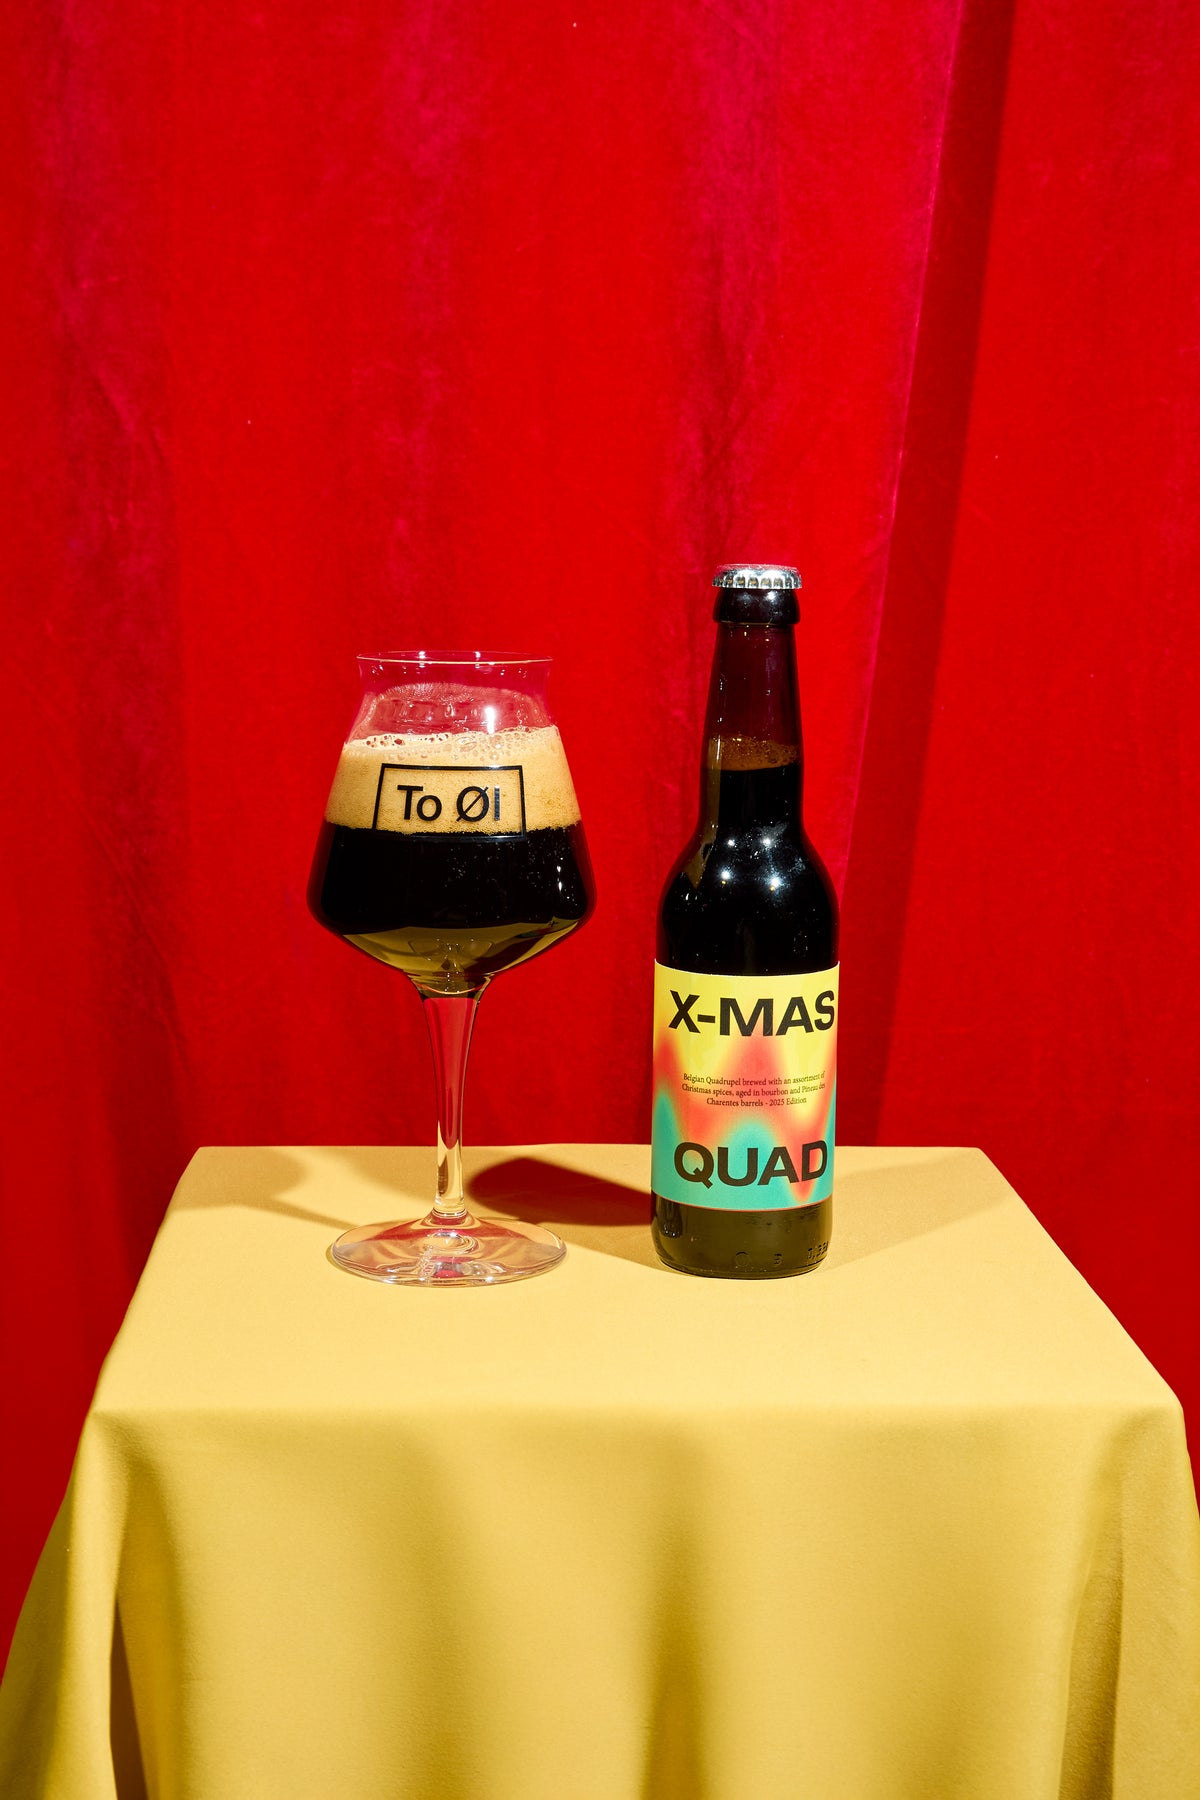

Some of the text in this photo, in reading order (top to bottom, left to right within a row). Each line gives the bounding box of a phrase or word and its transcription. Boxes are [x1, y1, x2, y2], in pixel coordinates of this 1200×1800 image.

[397, 785, 501, 822] To Øl
[668, 989, 835, 1037] X-MAS
[681, 1083, 712, 1094] Christmas
[712, 1087, 734, 1097] spices,
[735, 1088, 752, 1098] aged
[761, 1088, 789, 1097] bourbon
[790, 1086, 801, 1095] and
[802, 1085, 818, 1093] Pineau
[683, 1072, 705, 1084] Belgian
[706, 1076, 741, 1087] Quadrupel
[742, 1077, 767, 1086] brewed
[768, 1076, 783, 1086] with
[793, 1073, 820, 1084] assortment
[706, 1097, 739, 1107] Charentes
[740, 1099, 764, 1107] barrels
[769, 1098, 785, 1107] 2025
[786, 1097, 807, 1106] Edition
[674, 1140, 828, 1189] QUAD
